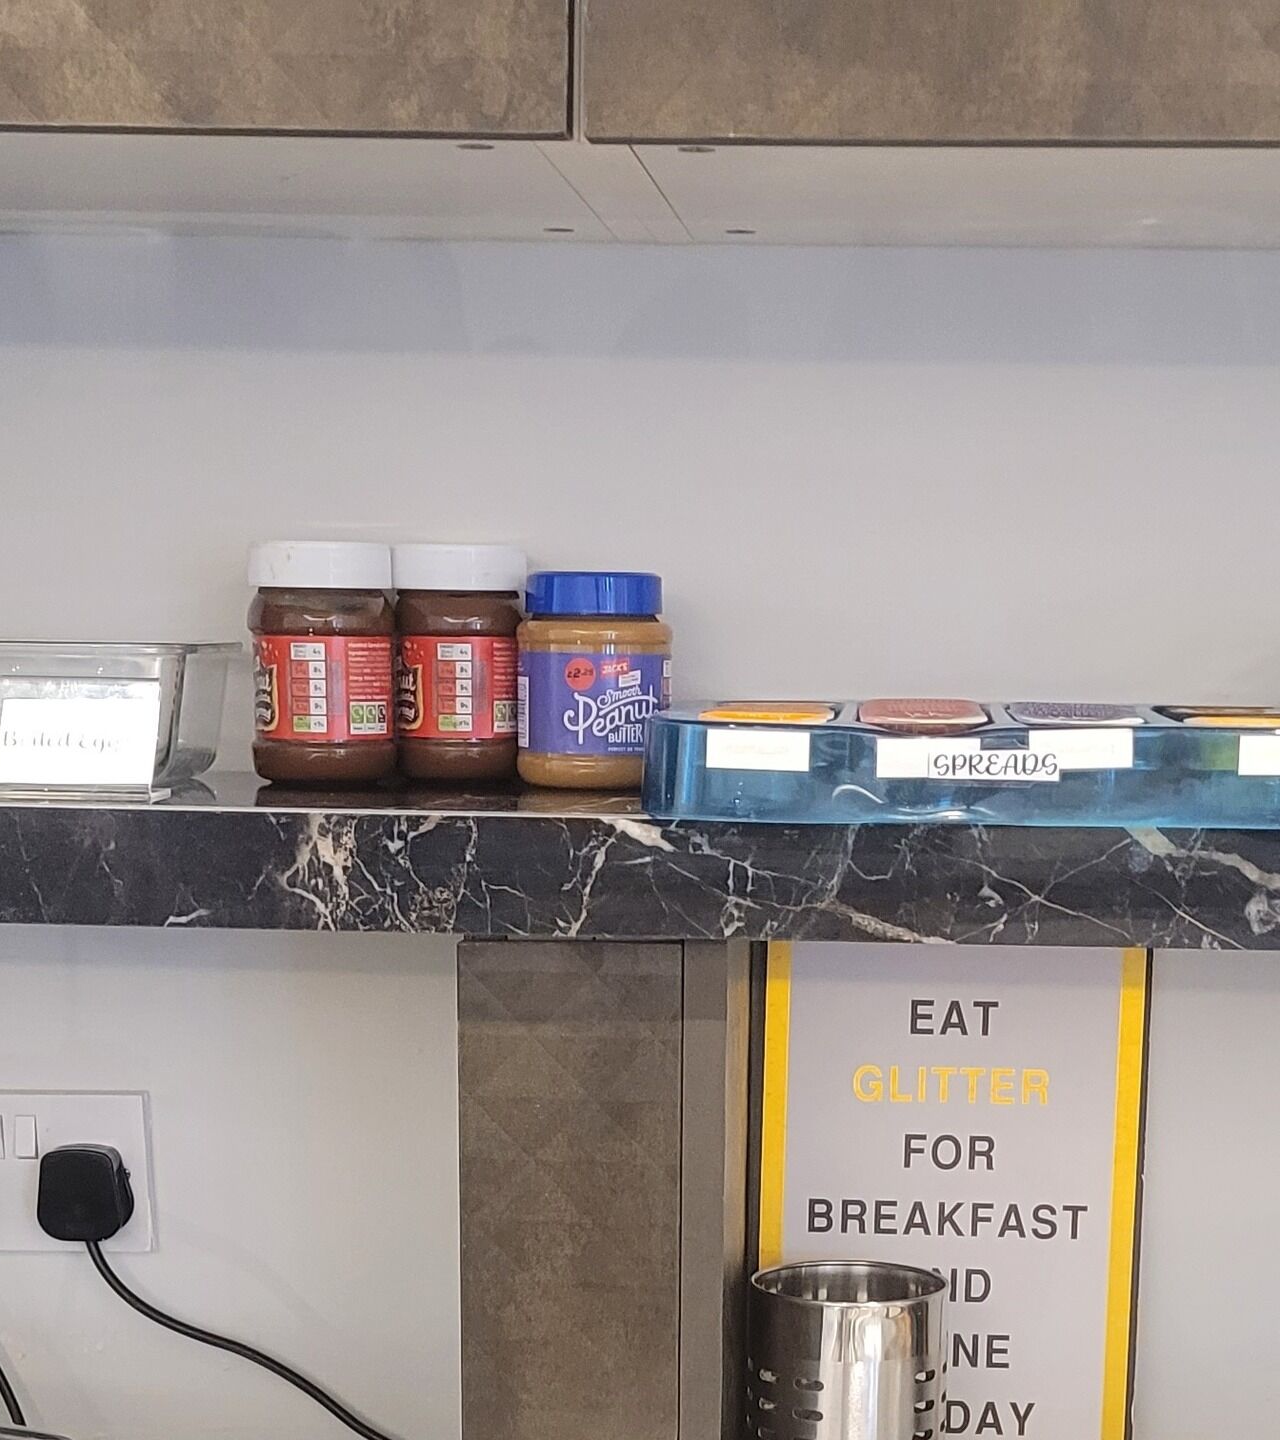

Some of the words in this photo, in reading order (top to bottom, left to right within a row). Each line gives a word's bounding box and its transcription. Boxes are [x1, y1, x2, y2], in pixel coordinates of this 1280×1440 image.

[564, 684, 659, 745] Peanut
[597, 685, 642, 708] Smooth
[608, 723, 644, 744] BUTTER
[933, 753, 1058, 776] SPREADS
[909, 999, 999, 1036] EAT
[852, 1064, 1050, 1106] GLITTER
[903, 1134, 995, 1171] FOR
[806, 1198, 1088, 1240] BREAKFAST
[945, 1400, 1035, 1436] DAY
